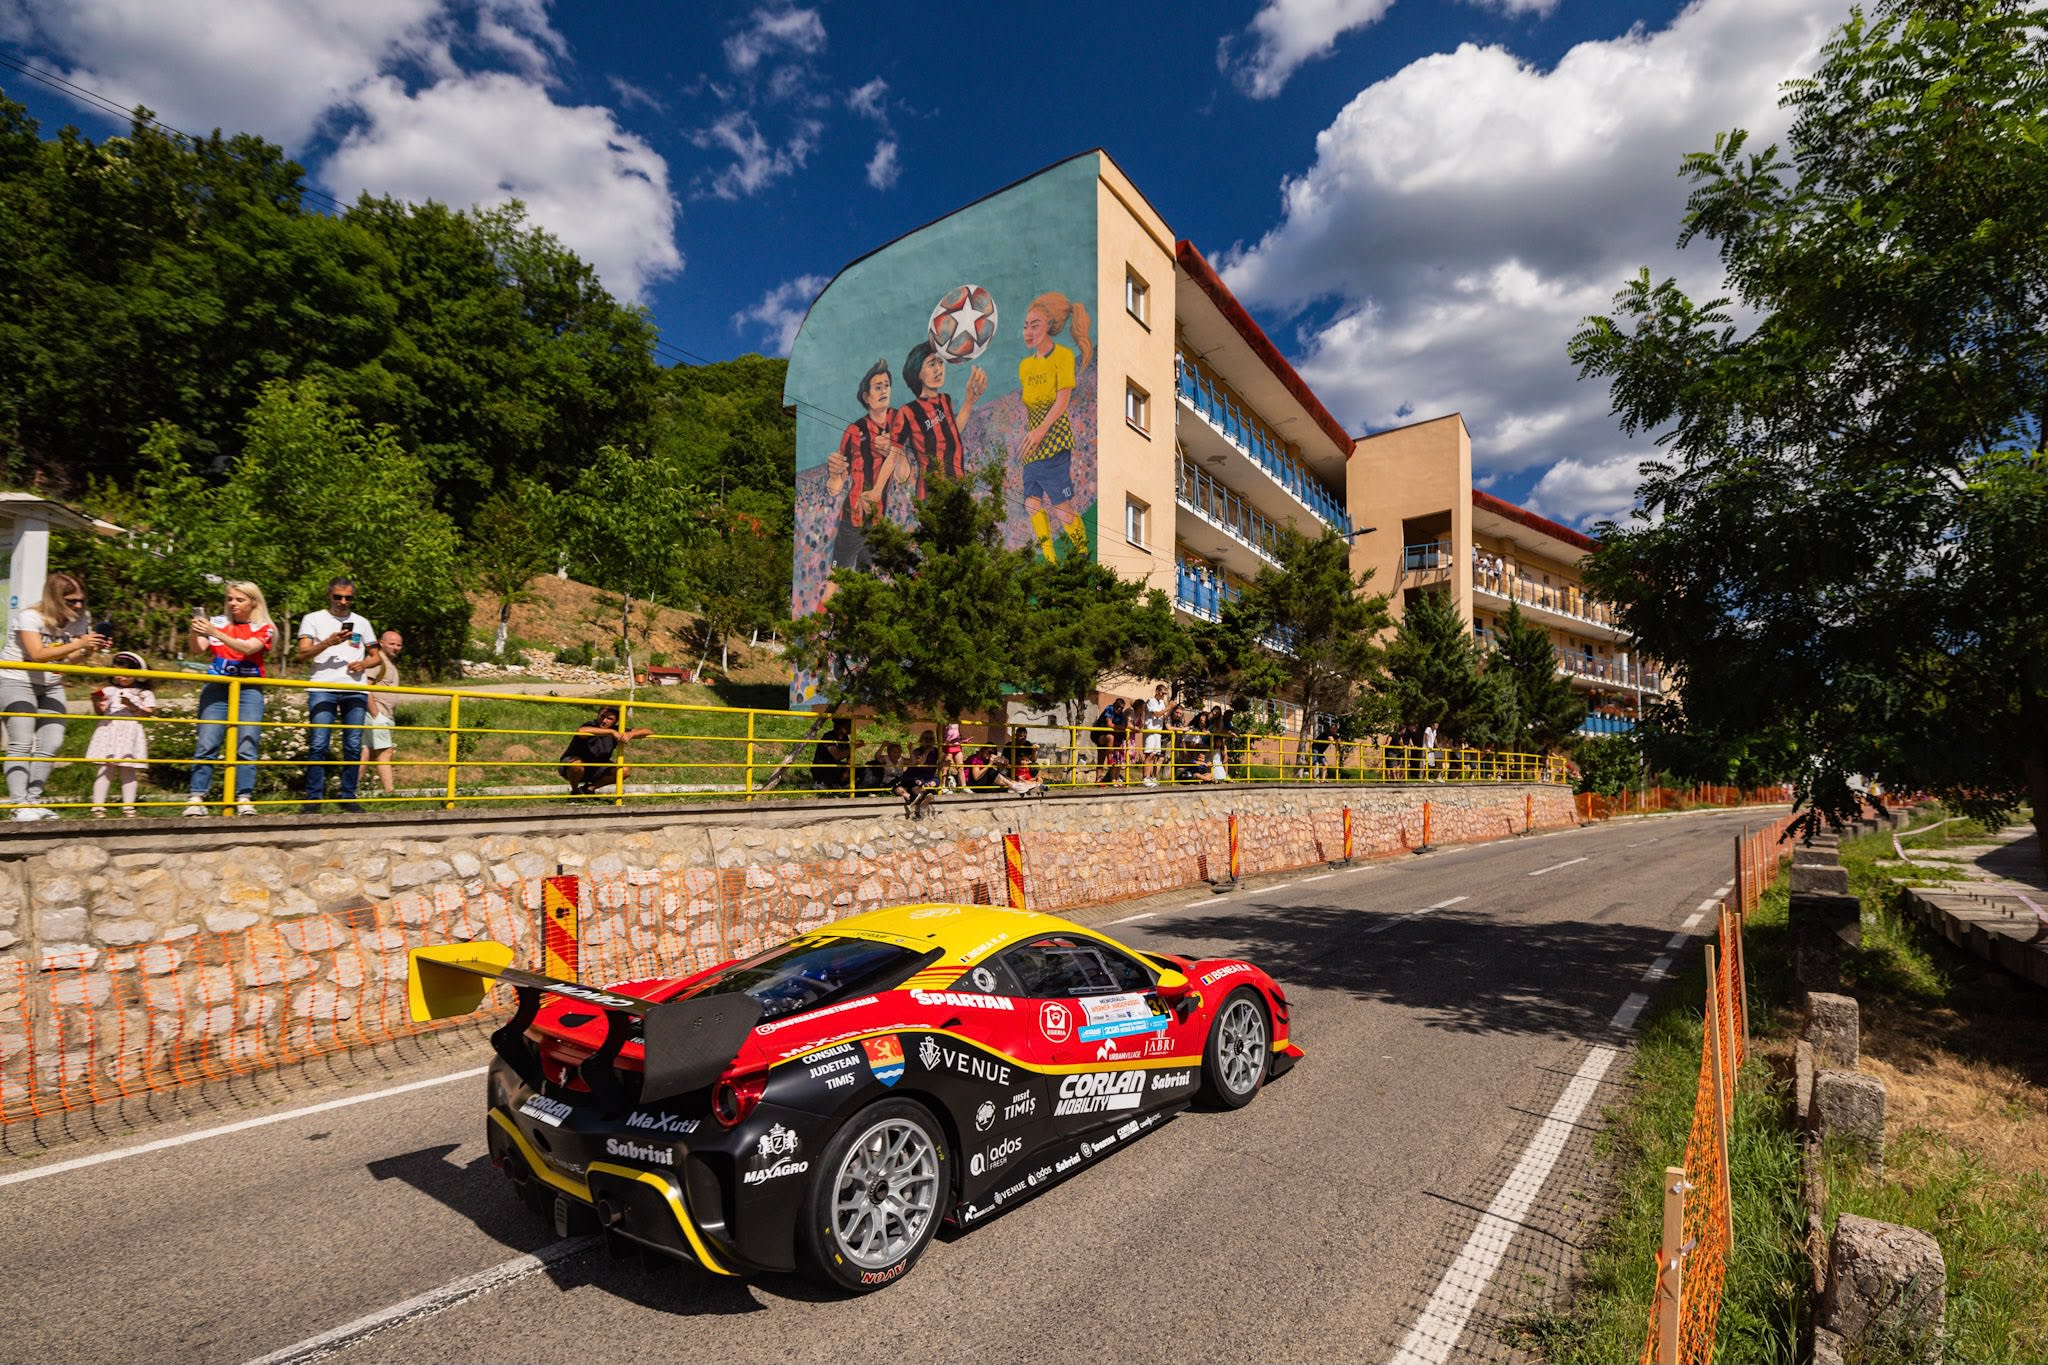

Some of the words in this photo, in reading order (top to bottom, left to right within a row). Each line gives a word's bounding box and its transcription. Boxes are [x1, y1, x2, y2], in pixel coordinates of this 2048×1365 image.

[1062, 487, 1072, 498] 10
[910, 989, 1014, 1010] SPARTAN
[1147, 998, 1169, 1016] 31
[802, 1043, 855, 1064] CONSILIUL
[1143, 1038, 1175, 1056] JABRI
[810, 1055, 861, 1079] JUDETEAN
[943, 1048, 1011, 1086] VENUE
[1059, 1070, 1147, 1099] CORLAN
[1151, 1071, 1191, 1091] Sabrini
[526, 1093, 573, 1120] CORLAN
[1054, 1095, 1111, 1116] MOBILITY
[626, 1111, 700, 1133] MaXutil
[606, 1138, 673, 1165] Sabrini
[989, 1137, 1022, 1161] ados
[743, 1160, 809, 1184] MAXAGRO
[989, 1156, 1008, 1170] FRESH
[1055, 1152, 1082, 1173] Sabrini
[1001, 1180, 1028, 1200] VENUE
[861, 1258, 907, 1285] AVON
